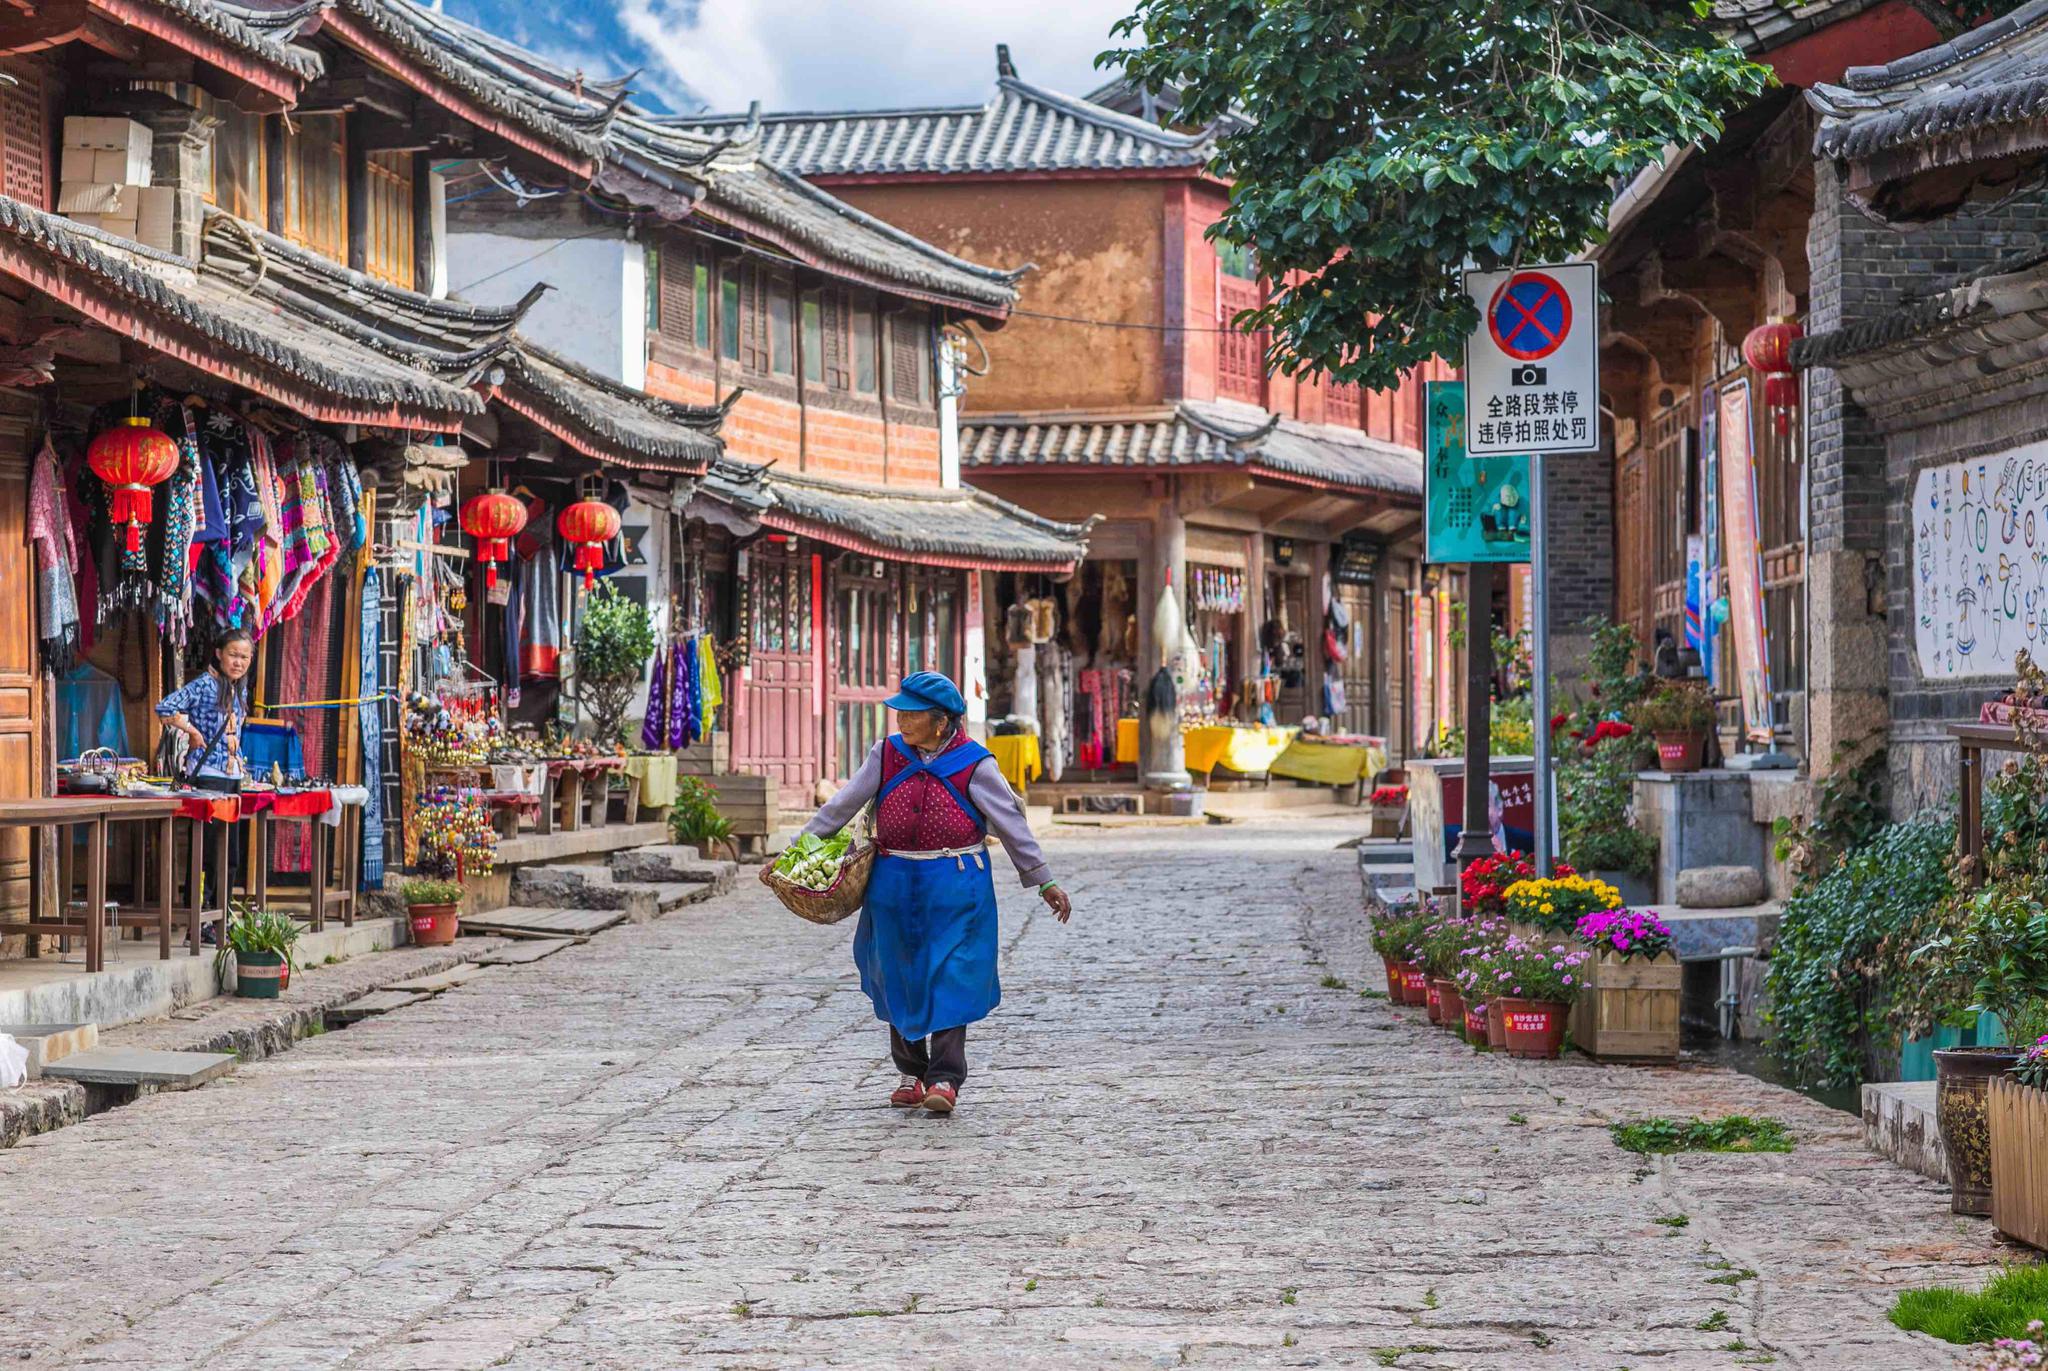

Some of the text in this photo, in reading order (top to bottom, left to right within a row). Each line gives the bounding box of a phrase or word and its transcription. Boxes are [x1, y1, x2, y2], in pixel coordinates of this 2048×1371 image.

[1486, 391, 1579, 418] 全路段禁停
[1478, 418, 1587, 445] 违停拍照处罚
